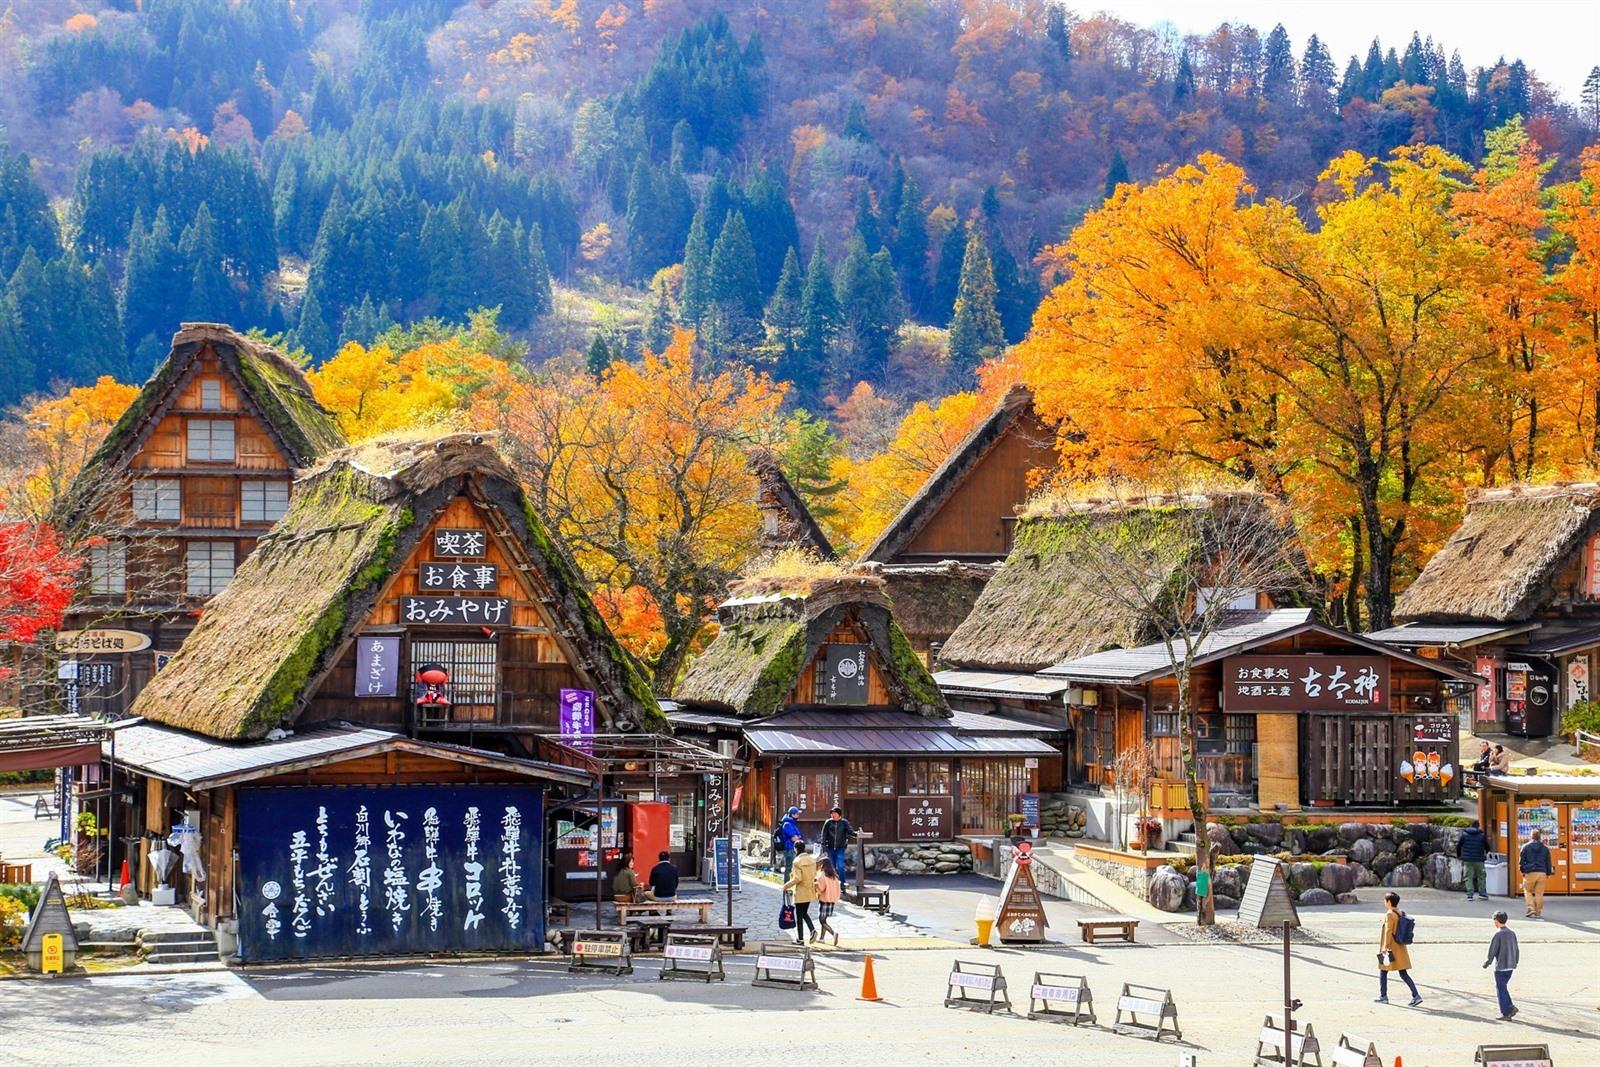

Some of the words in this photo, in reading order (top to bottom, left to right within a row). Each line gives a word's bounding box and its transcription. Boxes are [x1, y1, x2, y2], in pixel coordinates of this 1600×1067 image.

[436, 532, 485, 556] 喫茶
[425, 565, 495, 590] お食事
[406, 598, 509, 623] おみやげ
[368, 640, 385, 693] あまざけ
[1237, 685, 1291, 696] 地酒・土産
[1238, 667, 1289, 679] お食事処
[1481, 664, 1491, 712] おやげ
[708, 773, 722, 832] おみやげ
[911, 816, 939, 826] 地酒
[306, 806, 338, 916] とちもちぜんざい
[347, 805, 371, 935] 白川郷石割りとうふ
[384, 809, 410, 932] いわなの塩焼き
[417, 807, 443, 932] 飛騨牛串焼き
[463, 806, 485, 930] 飛騨牛コロッケ
[498, 806, 523, 929] 飛騨牛朴葉みそ
[584, 943, 619, 954] 駐停車禁止
